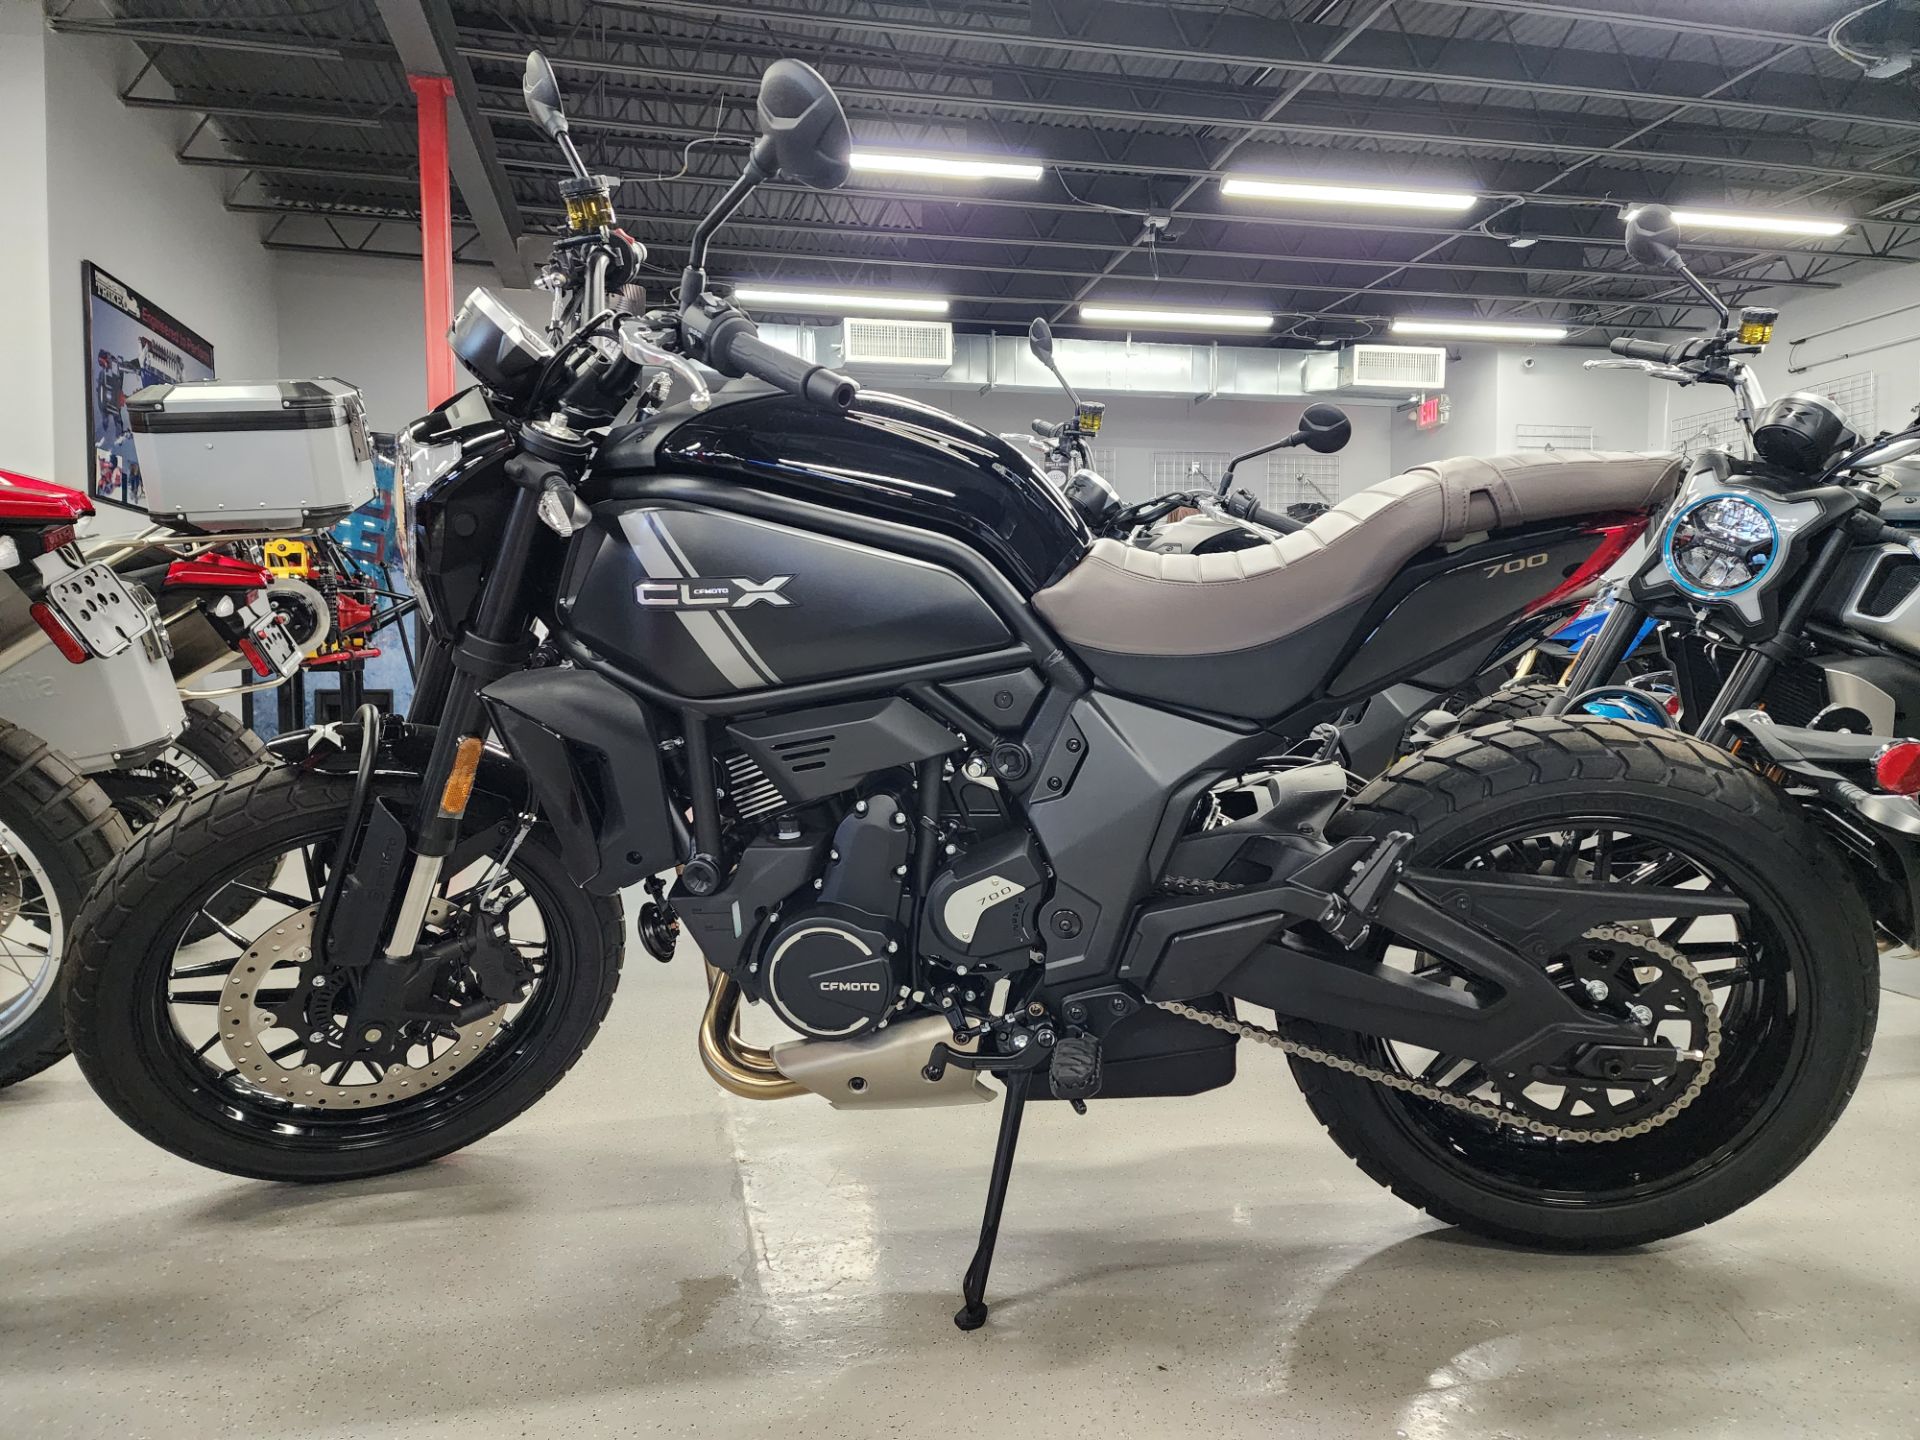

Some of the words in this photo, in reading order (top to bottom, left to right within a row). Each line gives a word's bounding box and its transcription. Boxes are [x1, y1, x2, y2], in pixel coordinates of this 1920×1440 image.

[1420, 398, 1439, 426] EXIT
[1484, 552, 1549, 579] 700
[635, 575, 793, 608] CLX
[693, 587, 729, 595] CFMOTO
[977, 886, 1012, 906] 700
[819, 981, 880, 992] CFMOTO
